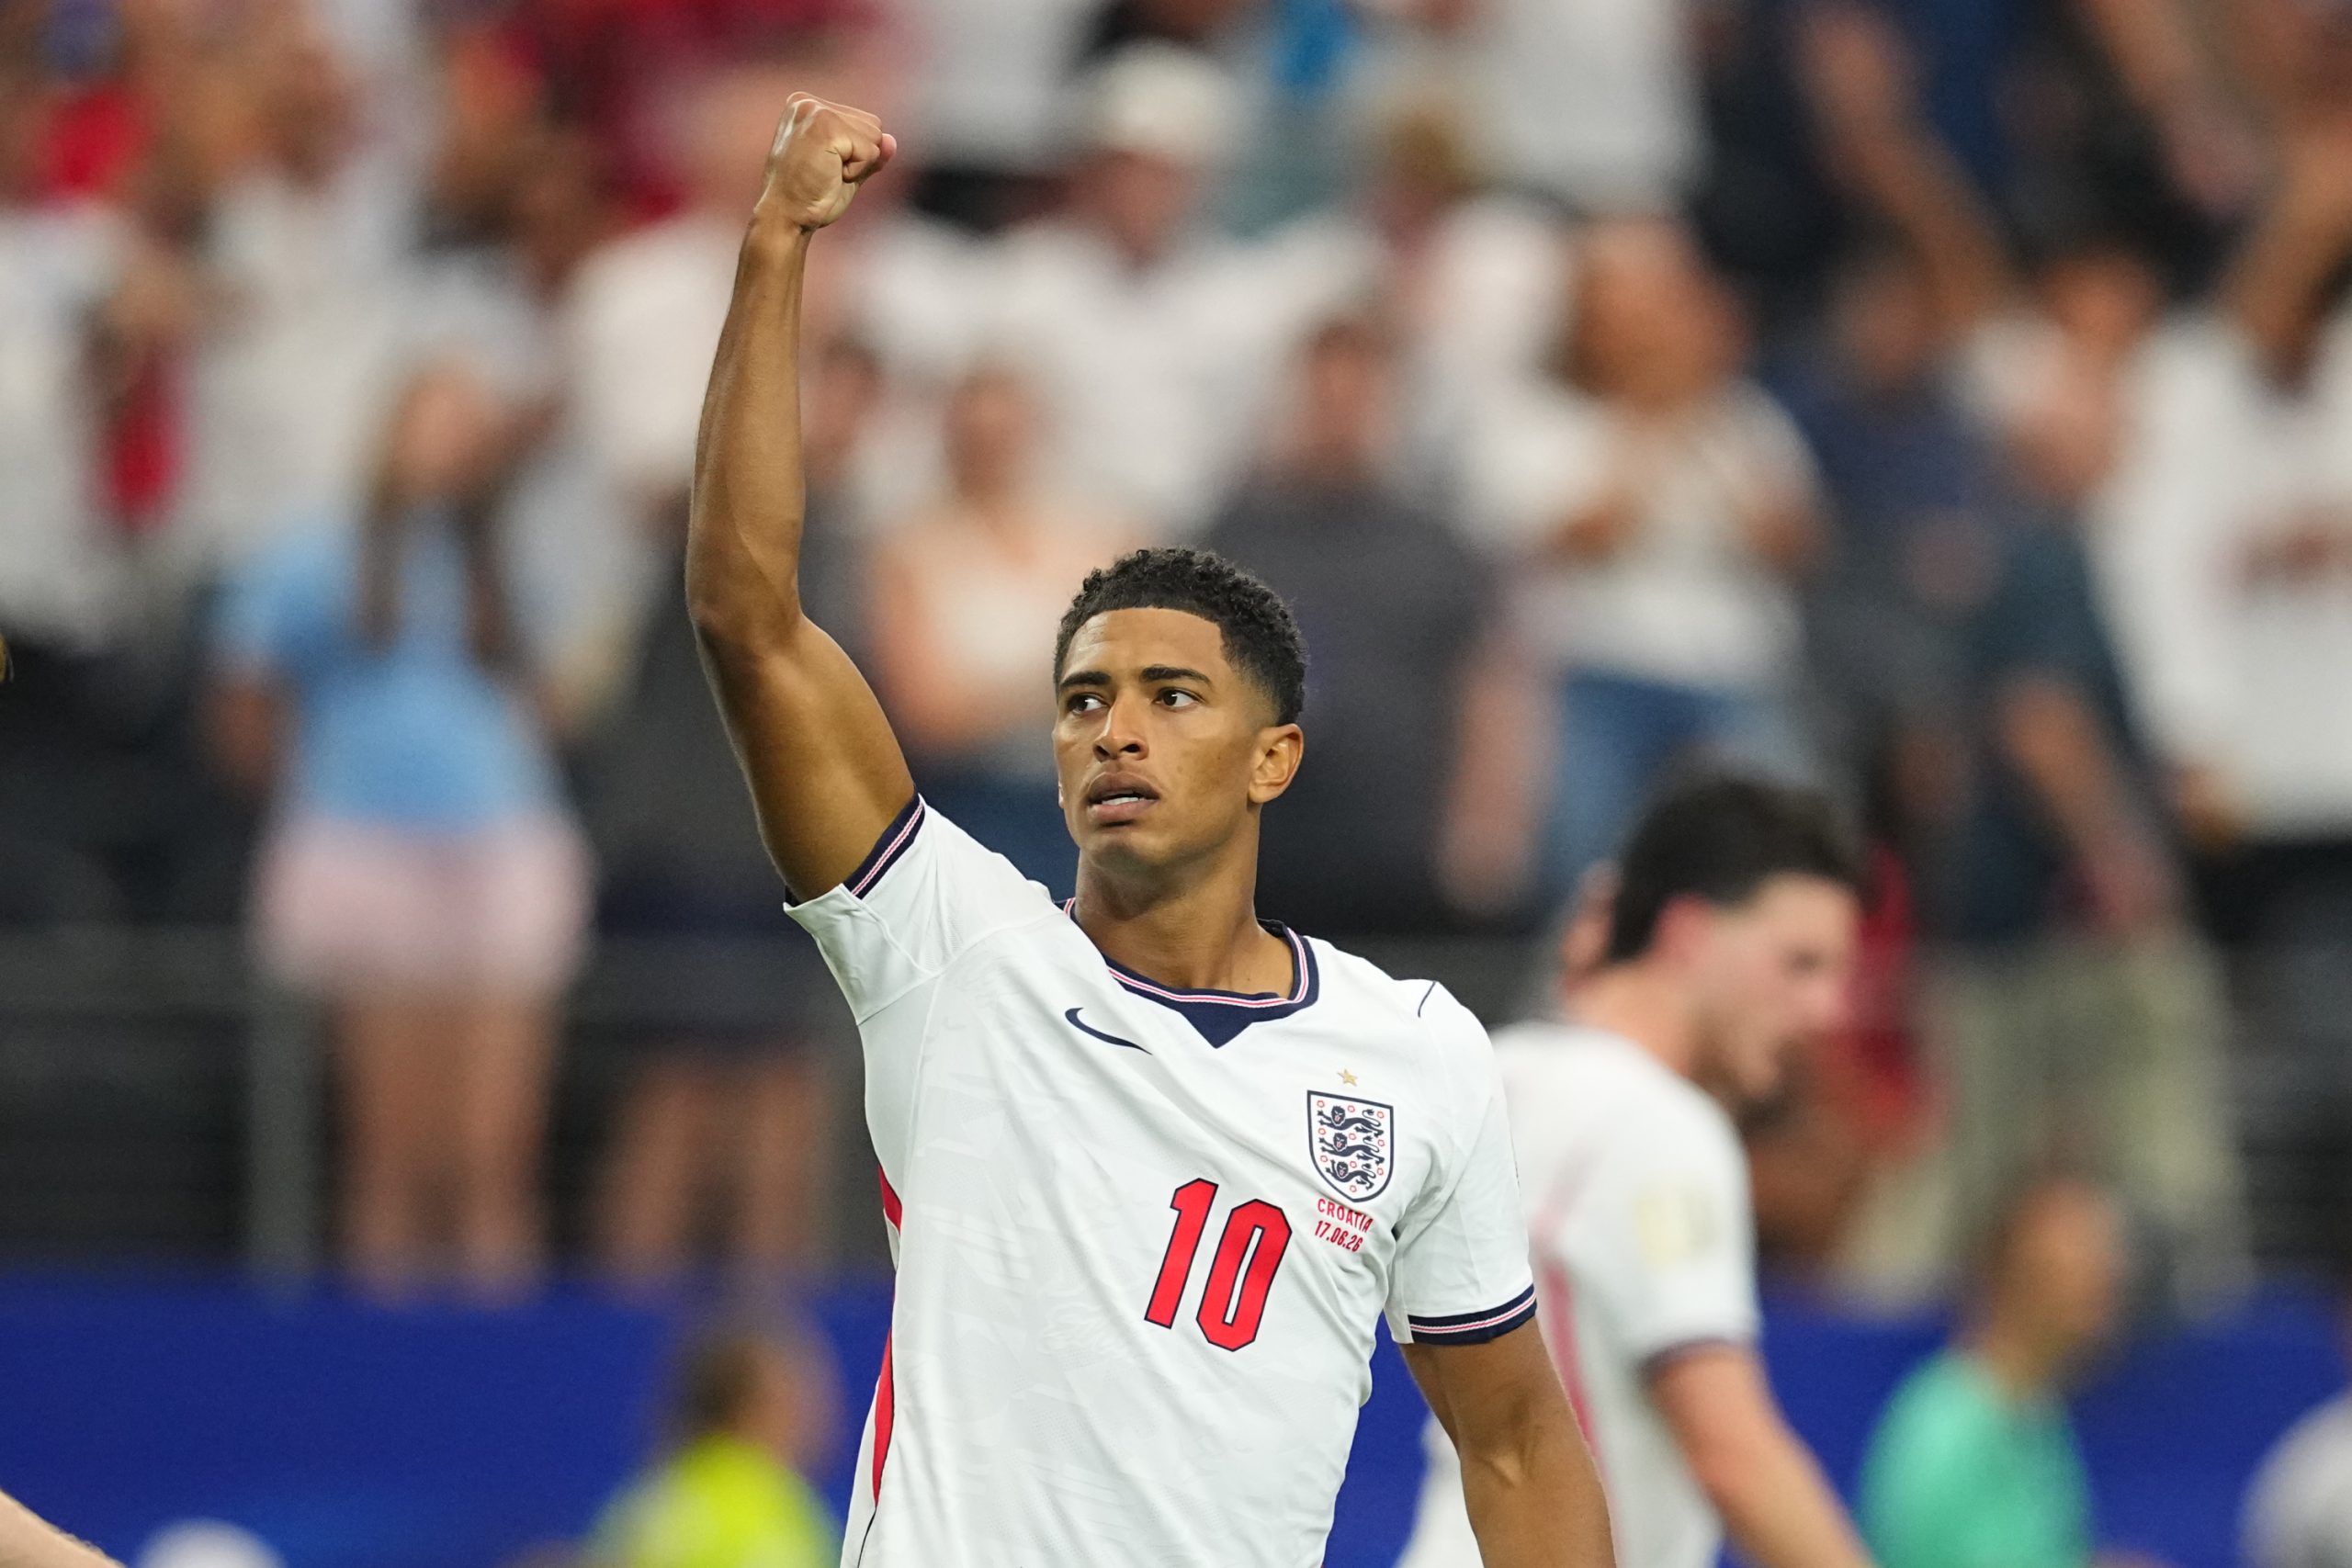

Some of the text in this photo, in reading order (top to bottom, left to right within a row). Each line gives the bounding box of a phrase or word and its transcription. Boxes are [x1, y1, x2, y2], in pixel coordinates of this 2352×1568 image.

[1317, 1198, 1374, 1233] CROATIA
[1314, 1220, 1363, 1252] 17.06.26
[1145, 1178, 1293, 1352] 10
